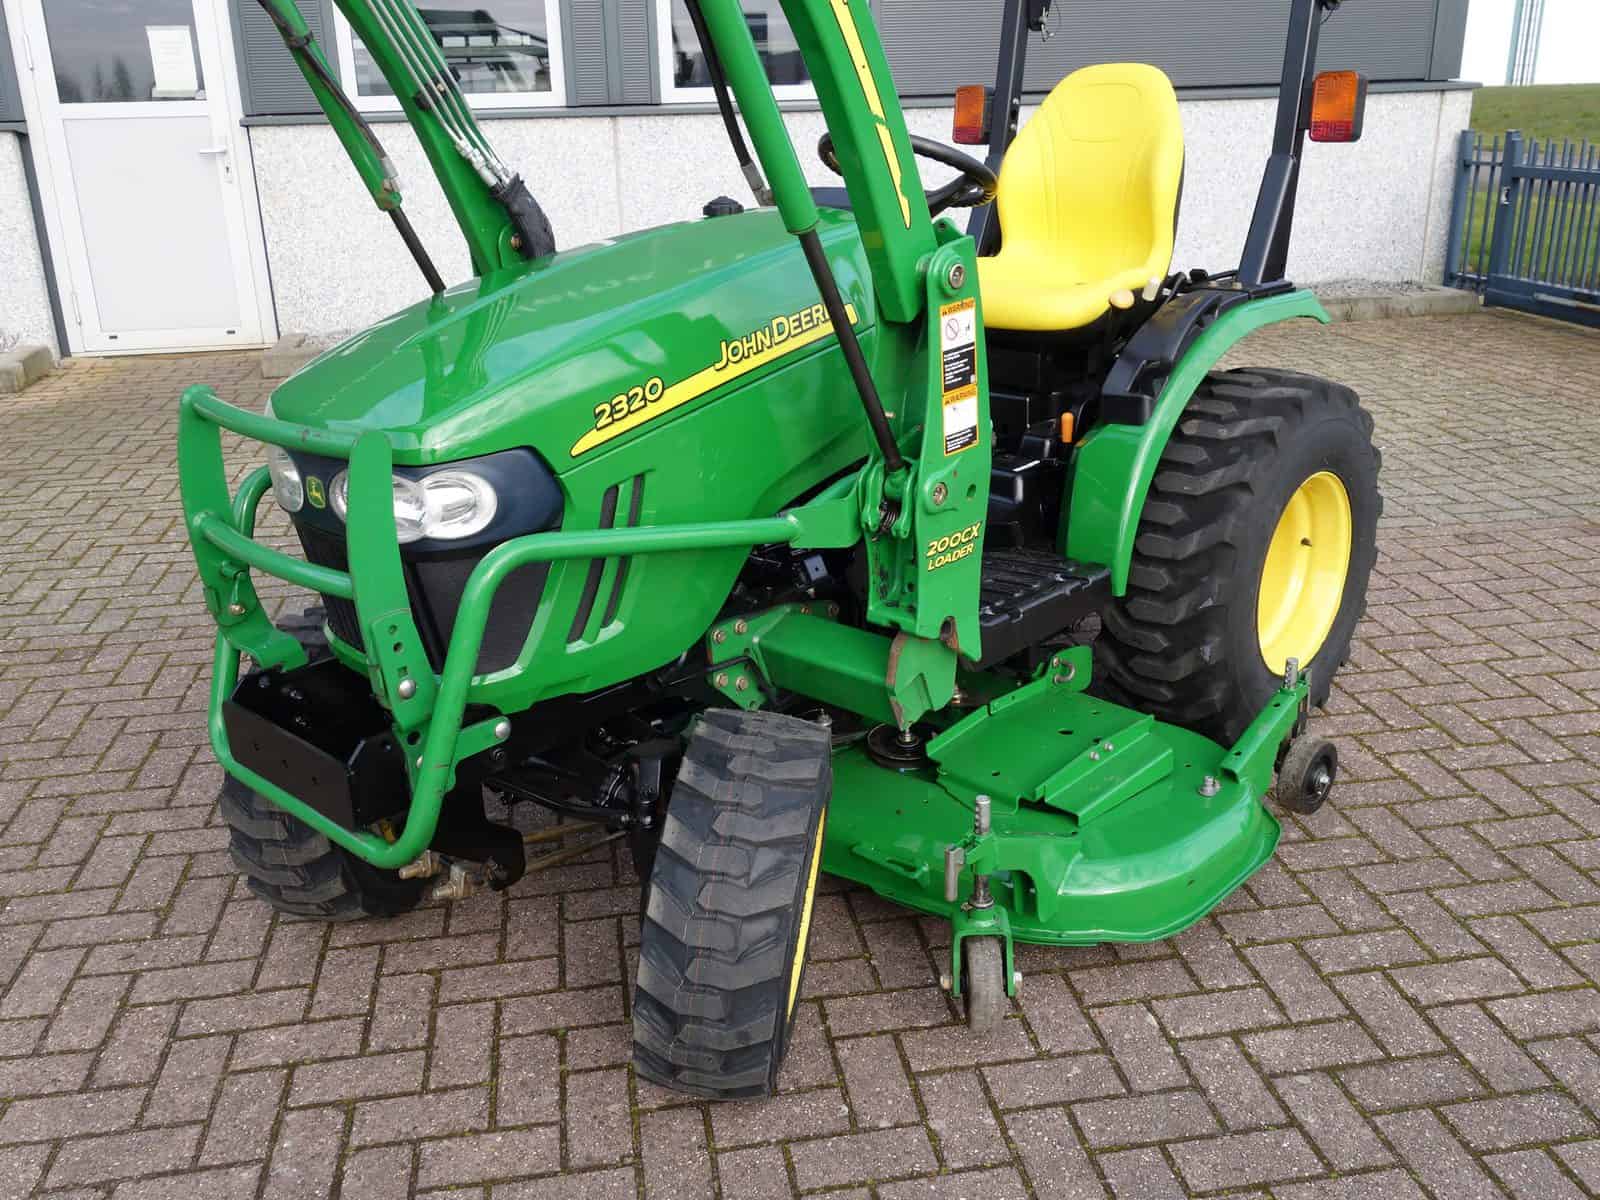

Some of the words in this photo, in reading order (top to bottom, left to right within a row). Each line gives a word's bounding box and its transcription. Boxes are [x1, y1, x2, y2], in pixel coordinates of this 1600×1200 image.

[714, 326, 774, 371] JOHN
[593, 376, 665, 431] 2320
[926, 521, 982, 557] 200CX
[927, 543, 975, 572] LOADER
